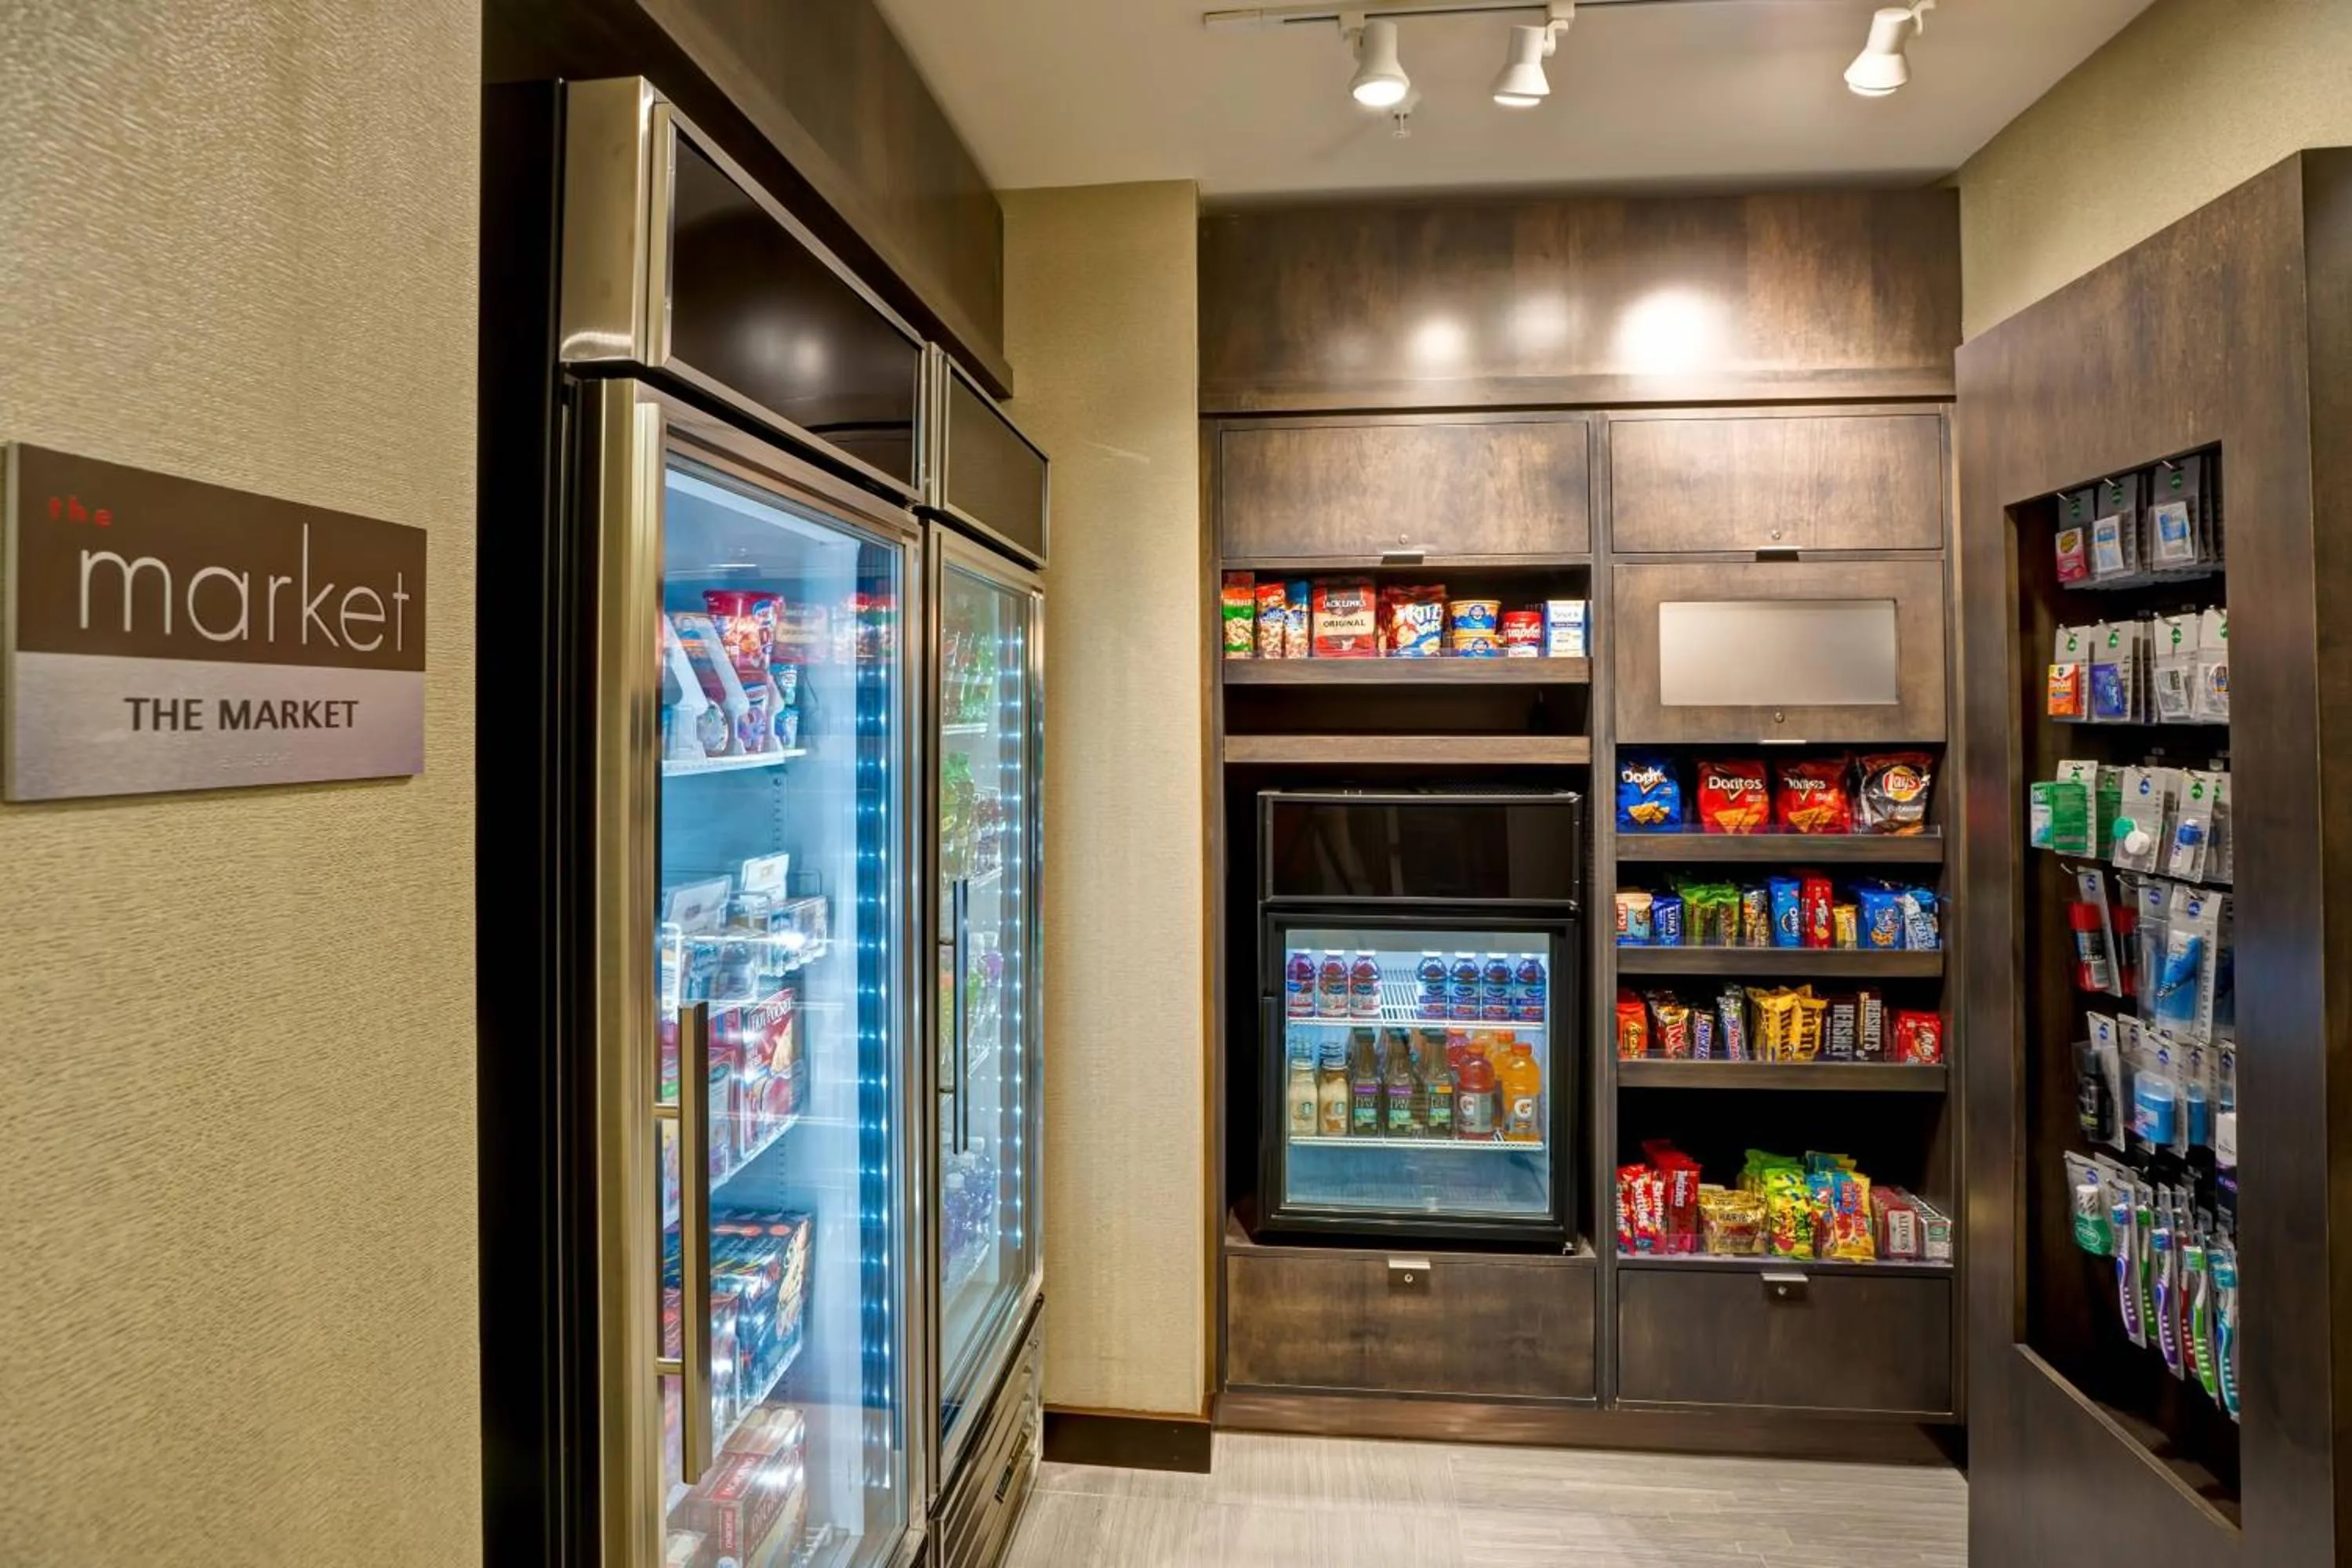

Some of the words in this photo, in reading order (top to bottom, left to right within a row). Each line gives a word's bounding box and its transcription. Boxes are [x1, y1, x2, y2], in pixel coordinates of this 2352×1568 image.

[49, 496, 112, 526] the
[81, 522, 410, 652] market
[124, 697, 204, 731] THE
[218, 699, 359, 730] MARKET
[1708, 775, 1764, 790] Doritos
[1667, 906, 1677, 935] LUNA
